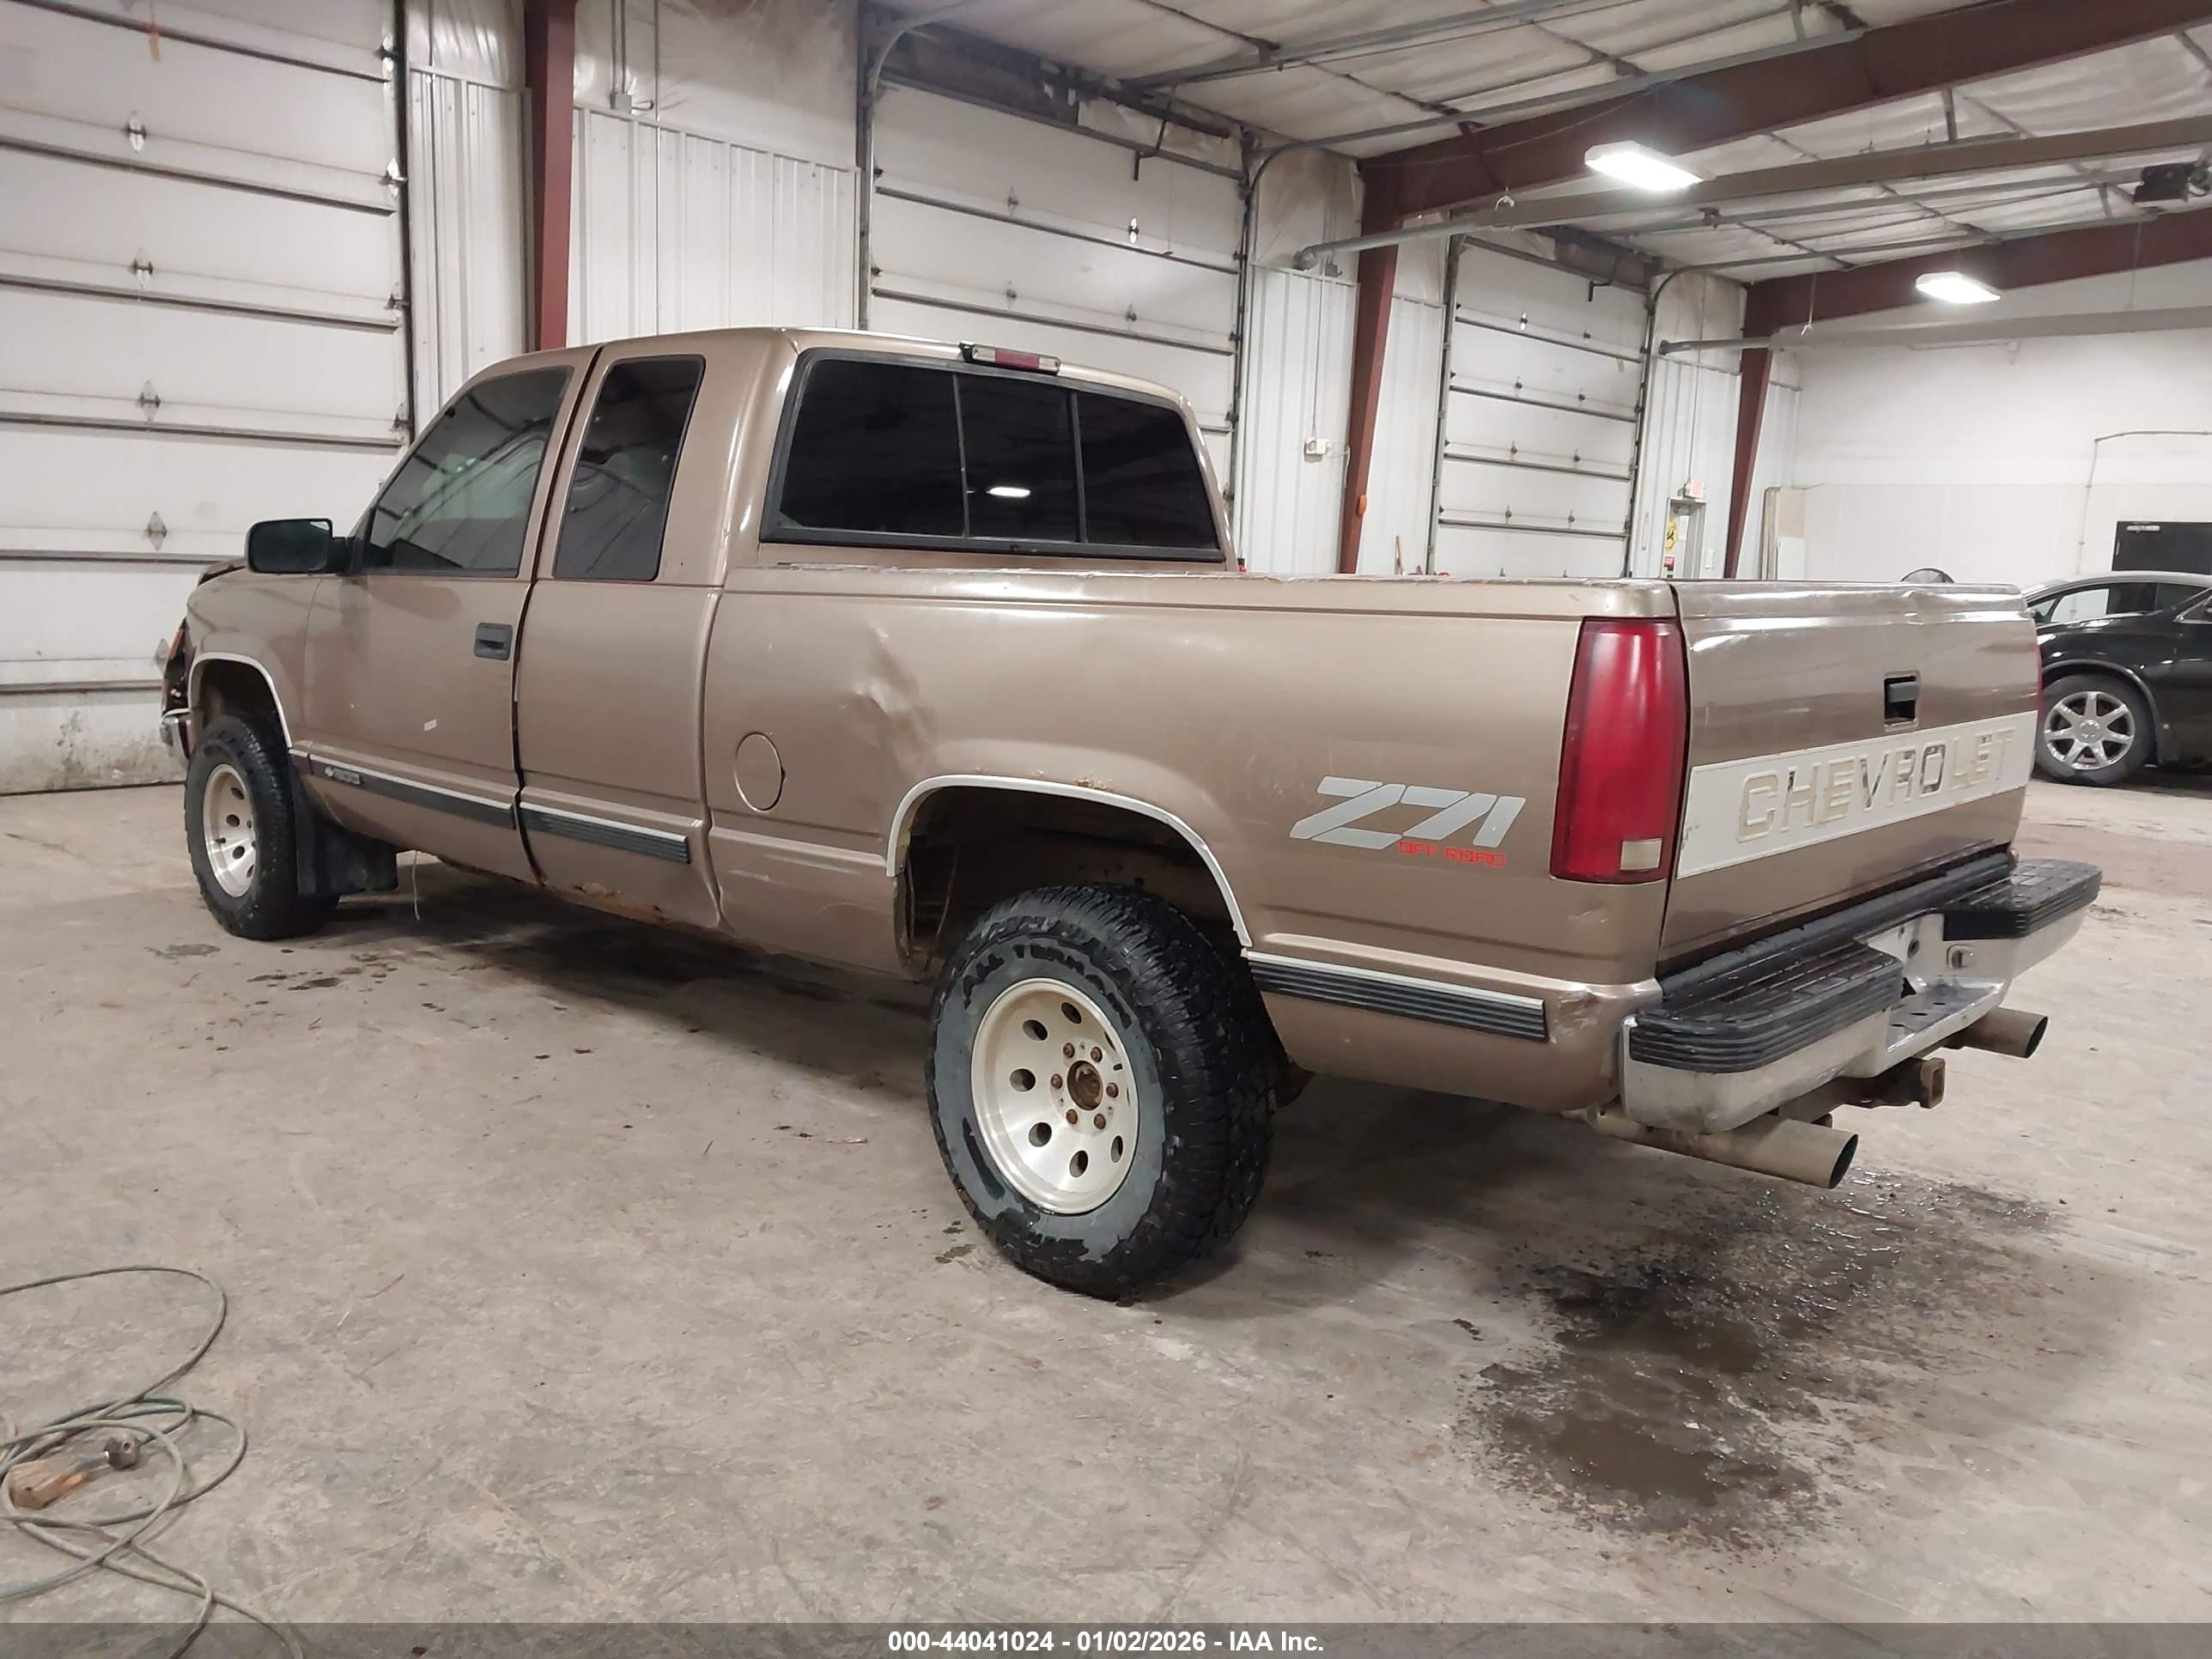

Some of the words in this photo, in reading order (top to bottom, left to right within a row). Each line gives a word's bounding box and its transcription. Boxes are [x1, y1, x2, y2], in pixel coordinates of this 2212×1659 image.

[1290, 775, 1526, 850] Z71
[1737, 727, 2015, 842] CHEVROLET
[1399, 840, 1438, 856] OFF
[1444, 846, 1506, 868] ROAD
